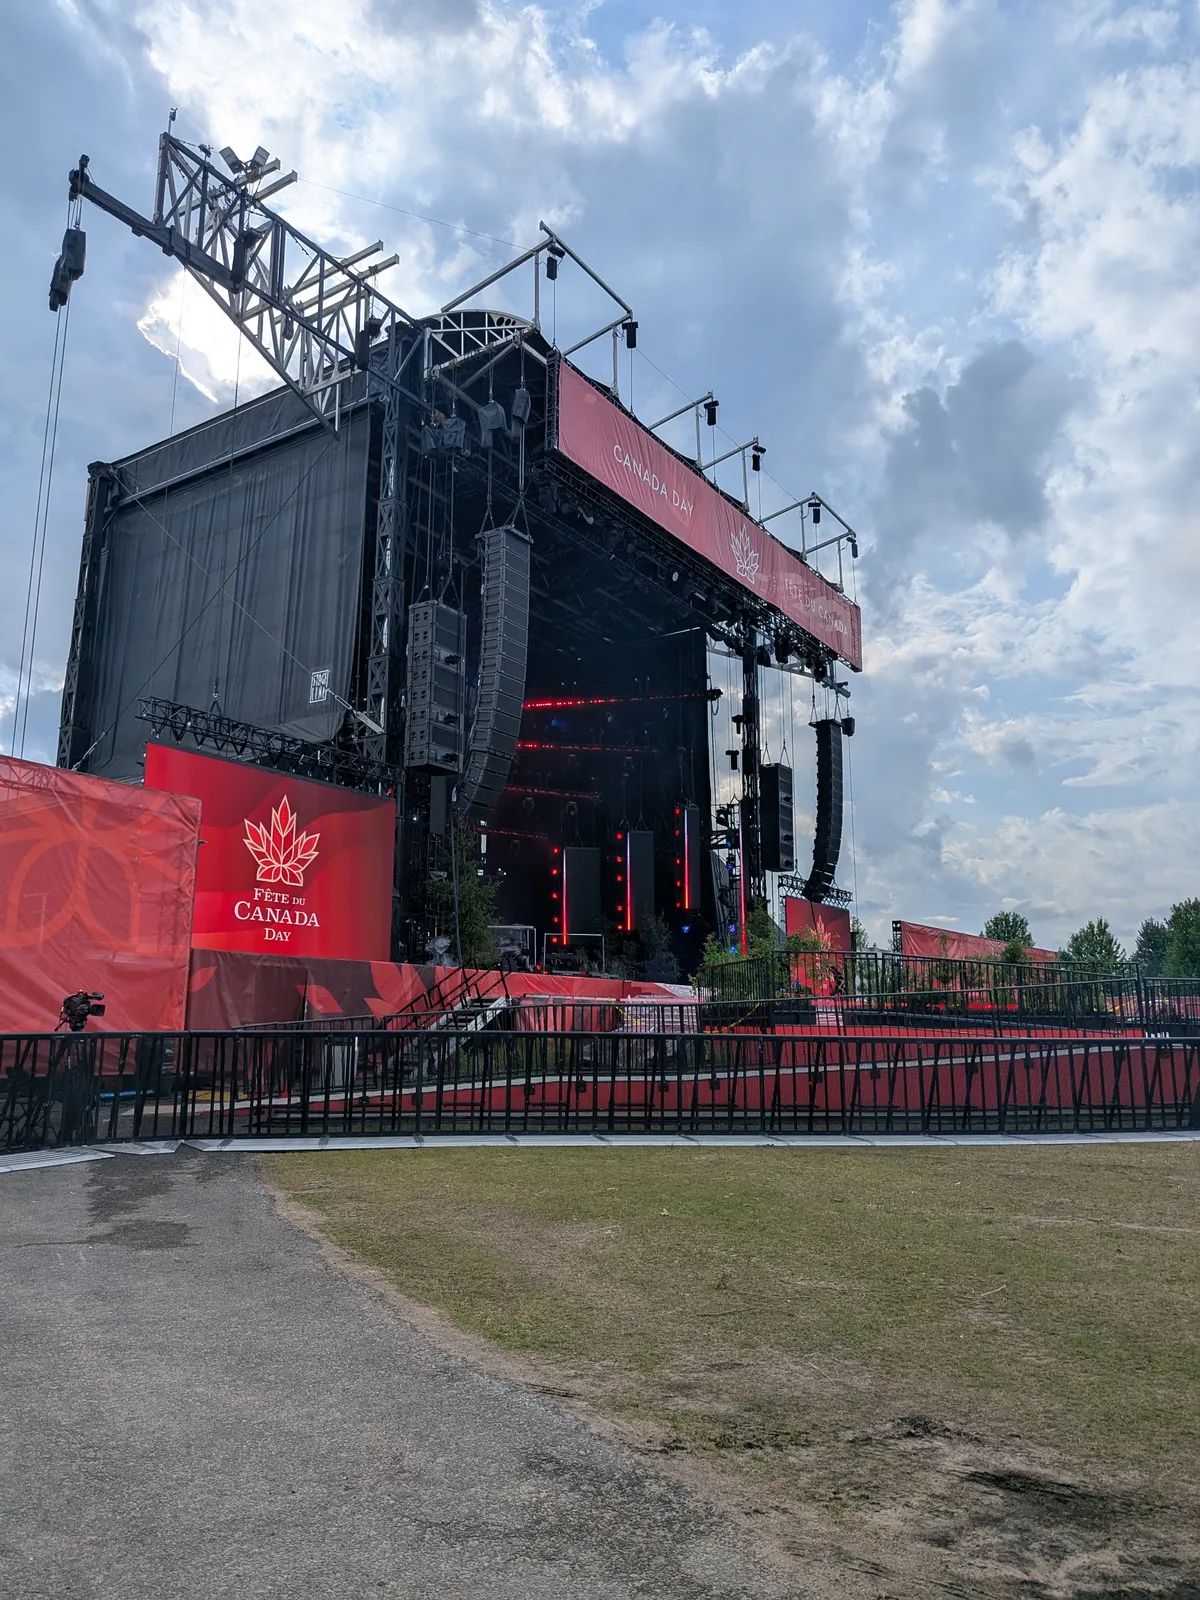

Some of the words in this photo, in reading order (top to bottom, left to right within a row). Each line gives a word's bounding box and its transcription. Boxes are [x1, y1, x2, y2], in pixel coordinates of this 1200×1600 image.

[613, 445, 668, 499] CANADA
[672, 490, 694, 517] DAY
[805, 594, 816, 612] DU
[818, 605, 848, 635] CANADA
[253, 888, 290, 904] FÊTE
[292, 897, 306, 906] DU
[234, 900, 320, 927] CANADA
[264, 928, 291, 942] DAY
